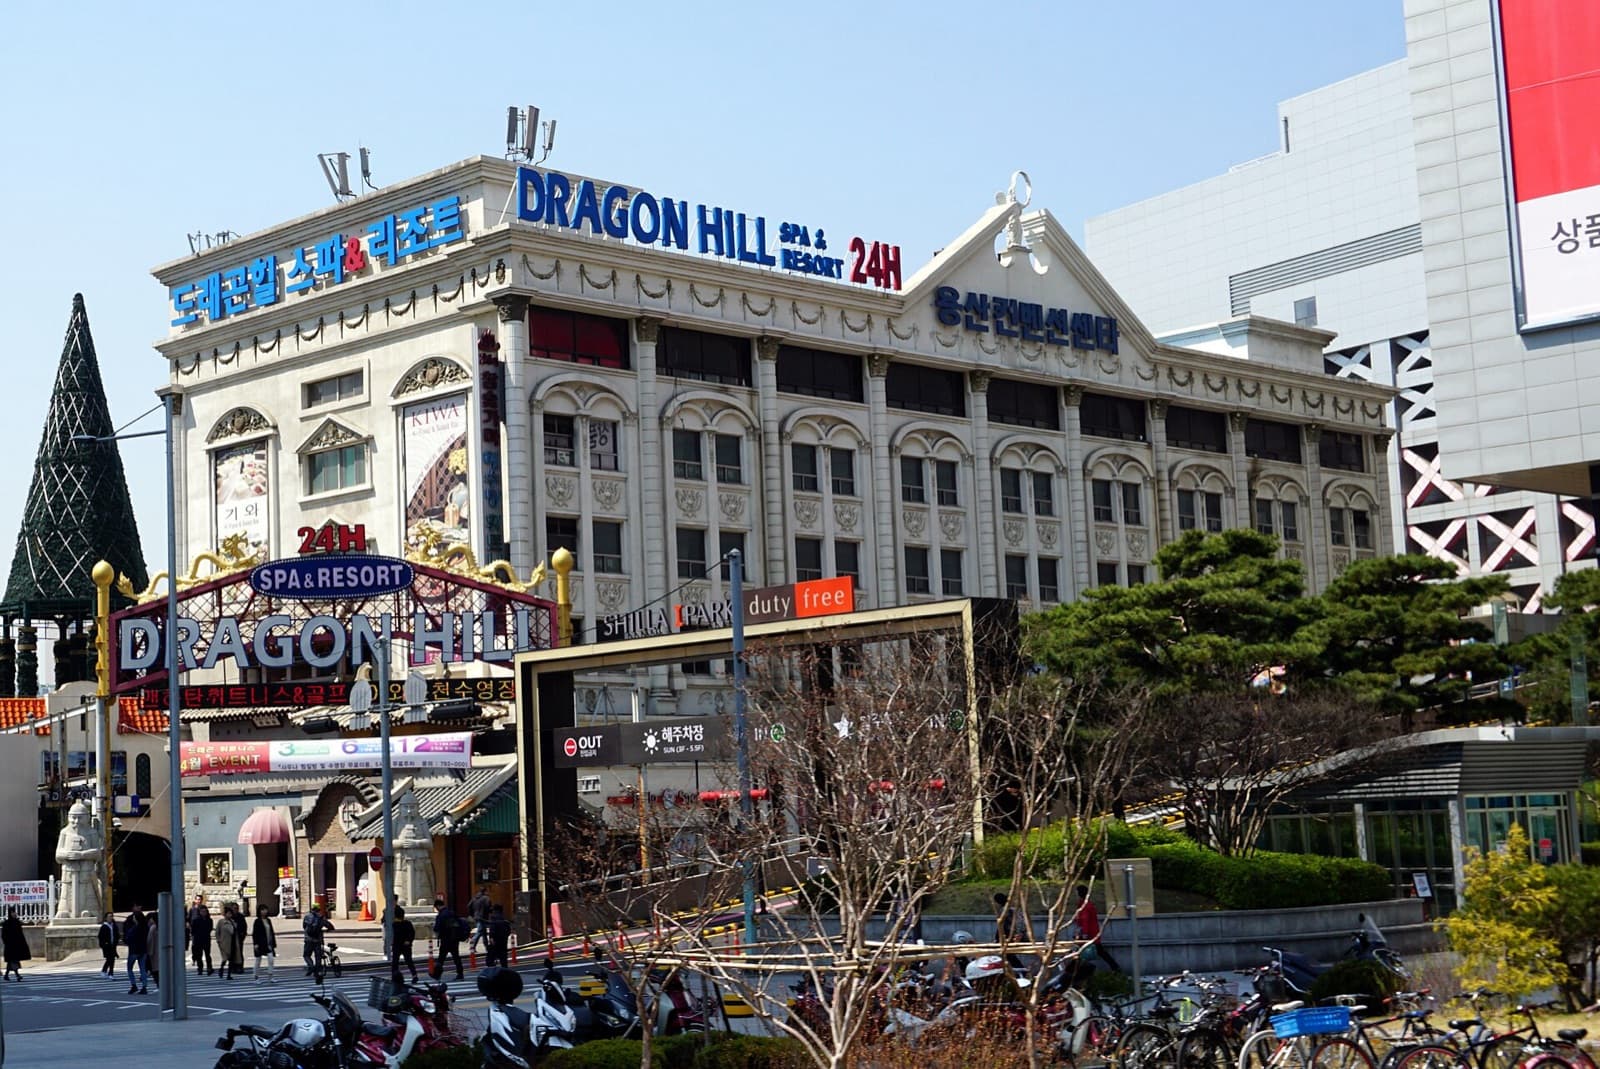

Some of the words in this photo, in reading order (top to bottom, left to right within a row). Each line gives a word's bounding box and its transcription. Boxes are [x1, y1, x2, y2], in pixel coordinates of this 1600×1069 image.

[515, 165, 689, 251] DRAGON
[697, 203, 776, 267] HILL
[779, 221, 812, 247] SPA
[814, 228, 828, 251] &
[780, 248, 845, 279] RESORT
[848, 236, 903, 291] 24H
[171, 255, 278, 327] 드래곤힐
[411, 401, 460, 428] KIWA
[297, 524, 368, 552] 24H
[259, 568, 301, 591] SPA
[303, 573, 314, 589] &
[317, 564, 405, 588] RESORT
[749, 594, 792, 618] duty
[802, 586, 846, 609] free
[603, 606, 671, 637] SHILLA
[119, 612, 392, 670] DRAGON
[413, 608, 531, 664] HILL
[341, 740, 359, 755] 6
[398, 737, 431, 753] 12
[578, 735, 603, 750] OUT
[661, 725, 705, 743] 해주차장
[209, 754, 261, 768] EVENT
[278, 742, 296, 756] 3
